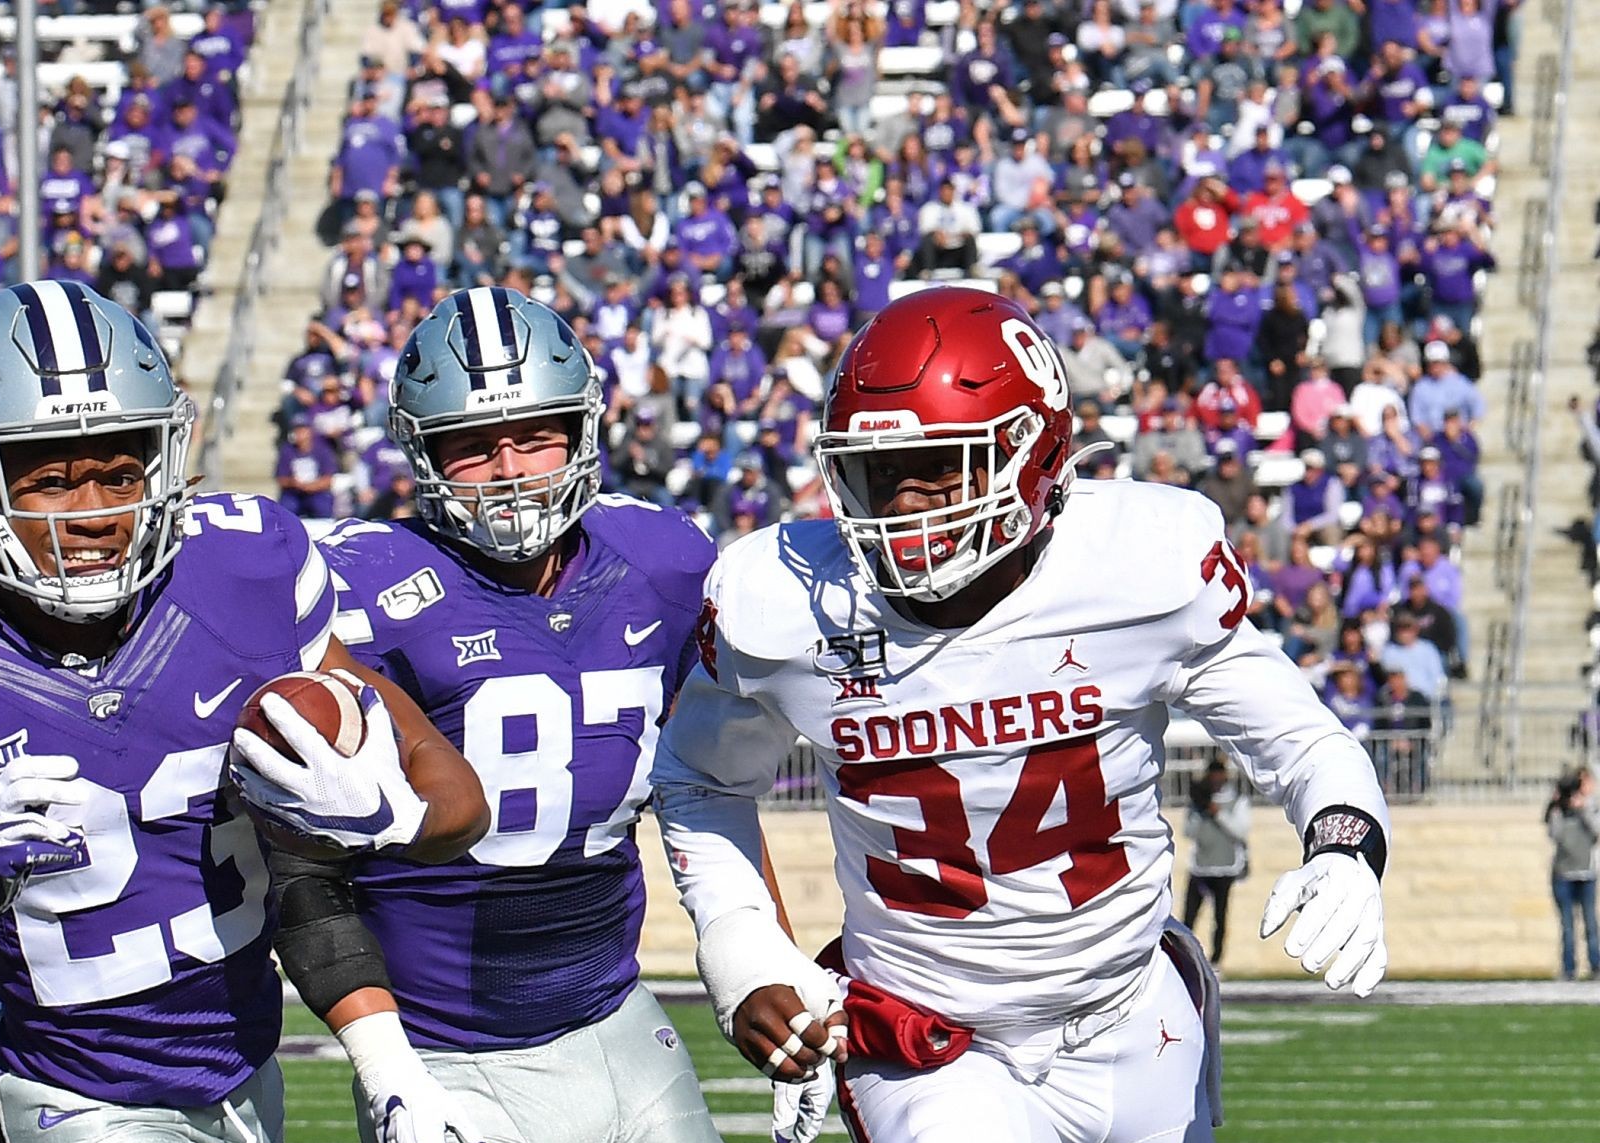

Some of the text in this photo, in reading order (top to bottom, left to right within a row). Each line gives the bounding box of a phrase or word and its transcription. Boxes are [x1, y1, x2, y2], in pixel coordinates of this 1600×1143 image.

[50, 400, 108, 415] K-STATE
[477, 390, 522, 404] K-STATE
[1000, 318, 1069, 412] OU
[1200, 540, 1250, 630] 3
[830, 684, 1104, 762] SOONERS
[832, 673, 883, 701] XII
[462, 665, 665, 867] 87
[836, 735, 1132, 920] 34
[12, 743, 273, 1008] 23
